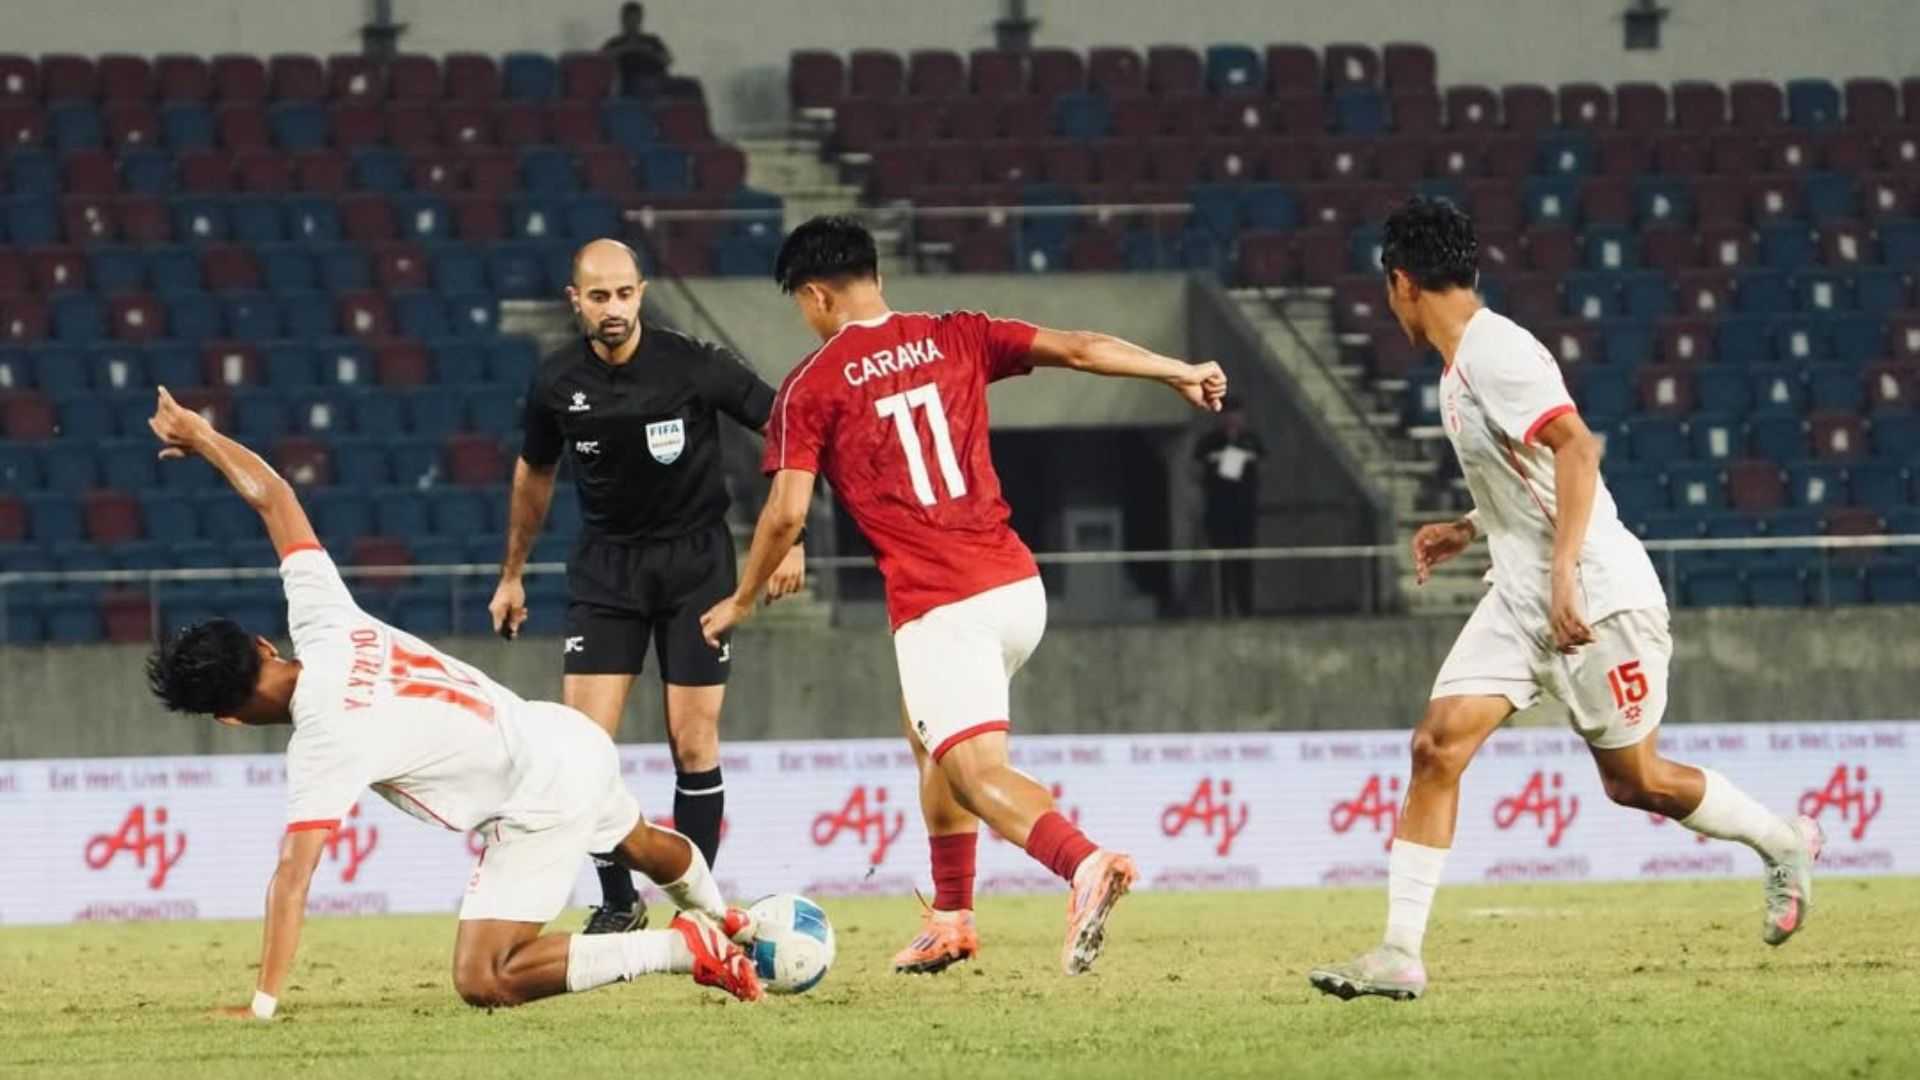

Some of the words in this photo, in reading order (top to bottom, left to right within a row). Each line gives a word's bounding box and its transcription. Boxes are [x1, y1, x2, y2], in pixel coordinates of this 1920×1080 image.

[844, 338, 945, 386] CARAKA
[650, 424, 679, 437] FIFA
[874, 382, 967, 507] 11
[1608, 661, 1648, 710] 15
[84, 804, 188, 890] Aj
[812, 785, 904, 865] Aj
[1161, 777, 1248, 857] Aj
[1493, 771, 1579, 847] Aj
